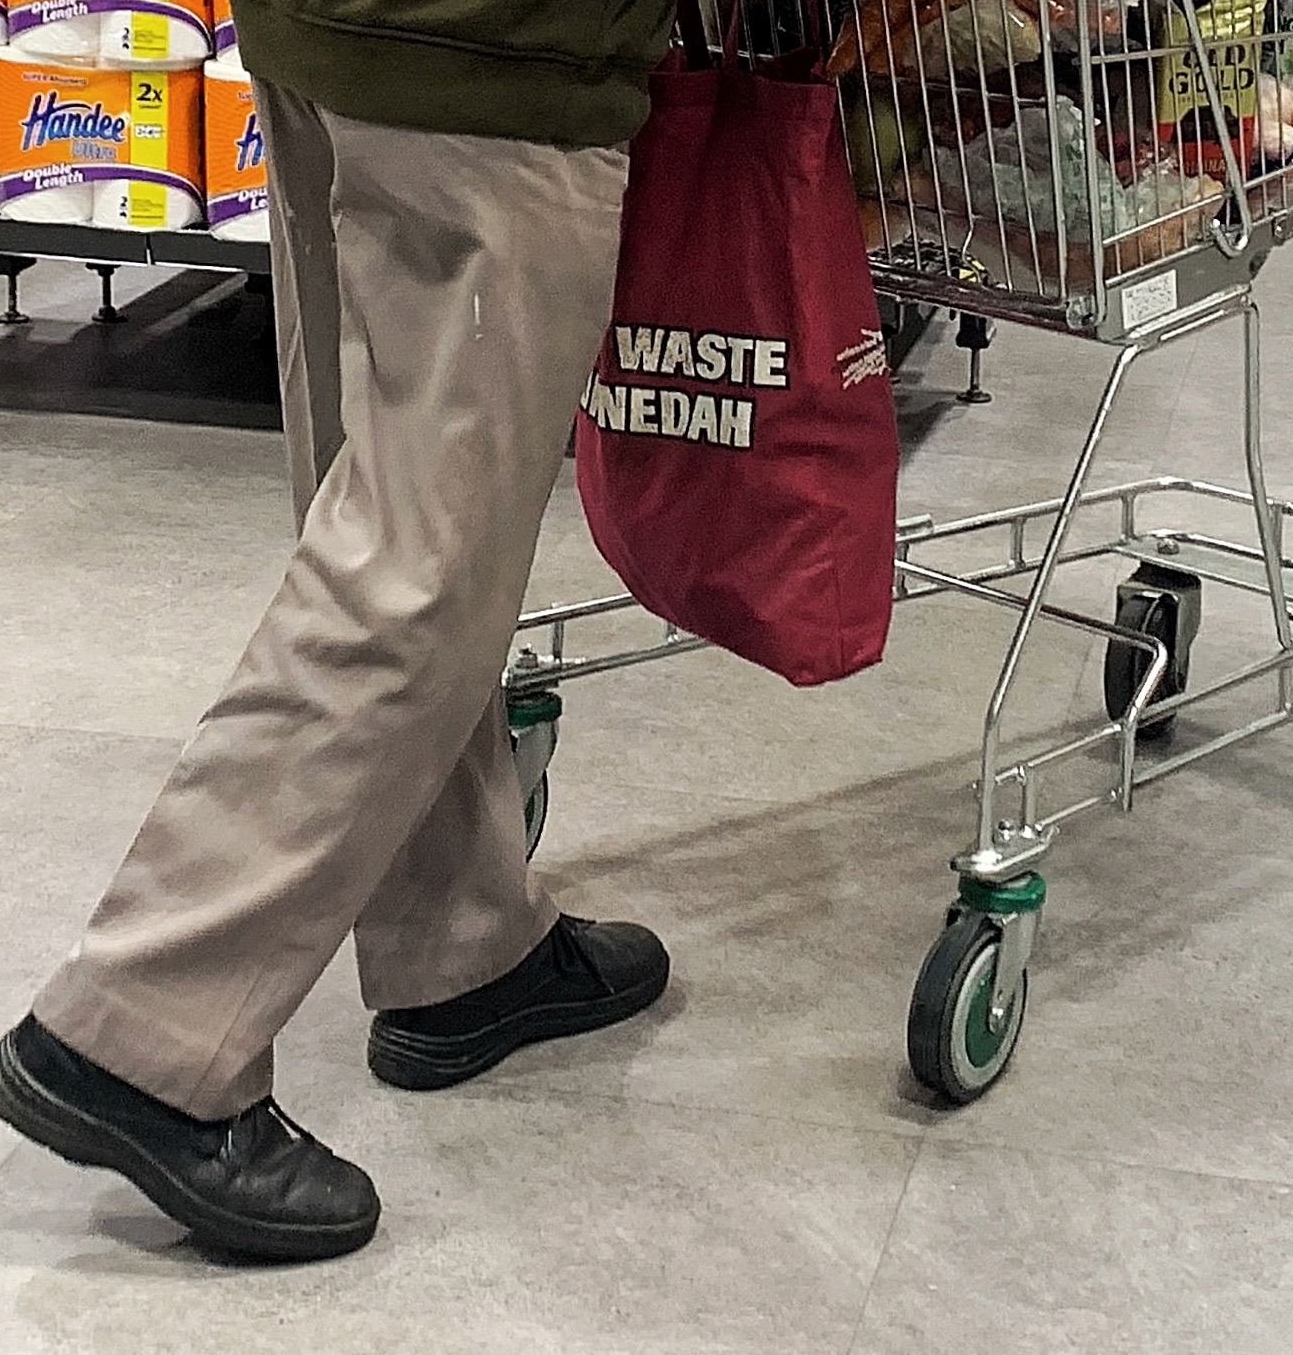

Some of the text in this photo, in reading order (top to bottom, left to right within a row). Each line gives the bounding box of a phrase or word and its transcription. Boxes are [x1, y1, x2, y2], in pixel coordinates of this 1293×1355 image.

[42, 3, 90, 24] Length
[136, 83, 164, 104] 2x
[21, 91, 127, 152] Handee
[23, 164, 73, 182] Double
[35, 173, 85, 191] Length
[238, 187, 269, 203] Dou
[616, 326, 789, 388] WASTE
